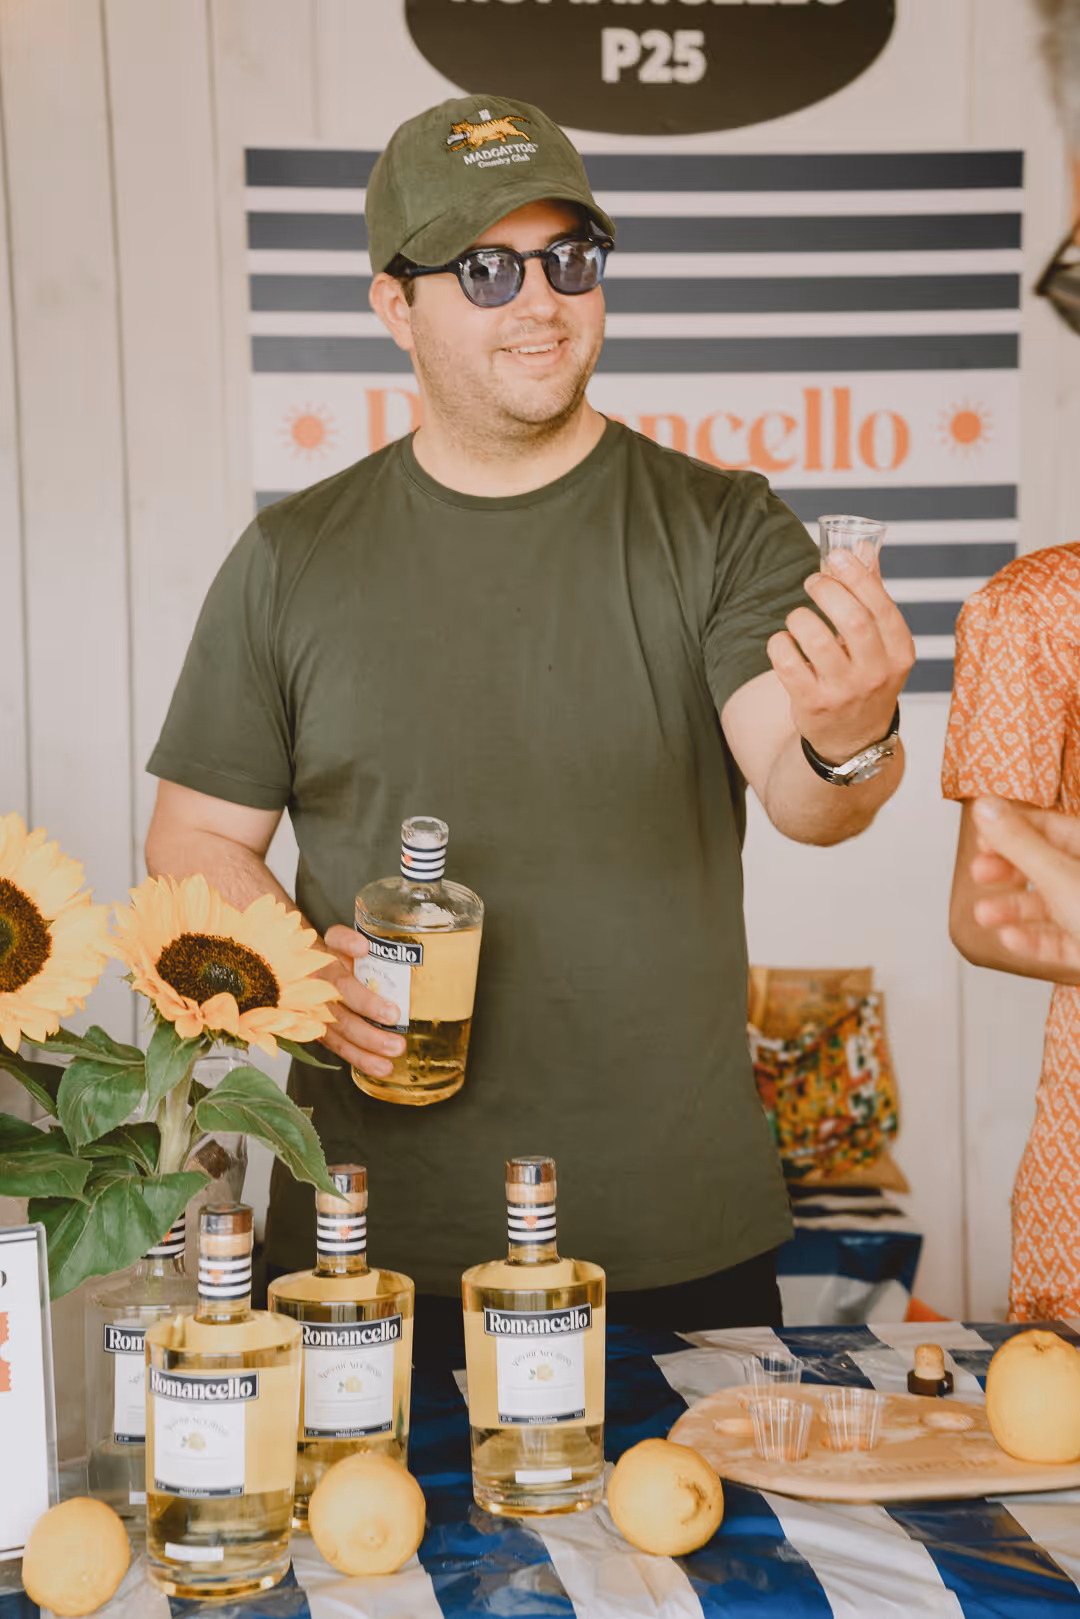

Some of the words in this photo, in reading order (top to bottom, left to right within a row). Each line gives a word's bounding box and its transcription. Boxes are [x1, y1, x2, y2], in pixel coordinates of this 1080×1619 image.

[602, 28, 706, 83] P25
[366, 387, 910, 474] Rncello
[301, 1320, 398, 1346] Romancello
[490, 1310, 588, 1334] Romancello
[151, 1369, 253, 1400] Romancello
